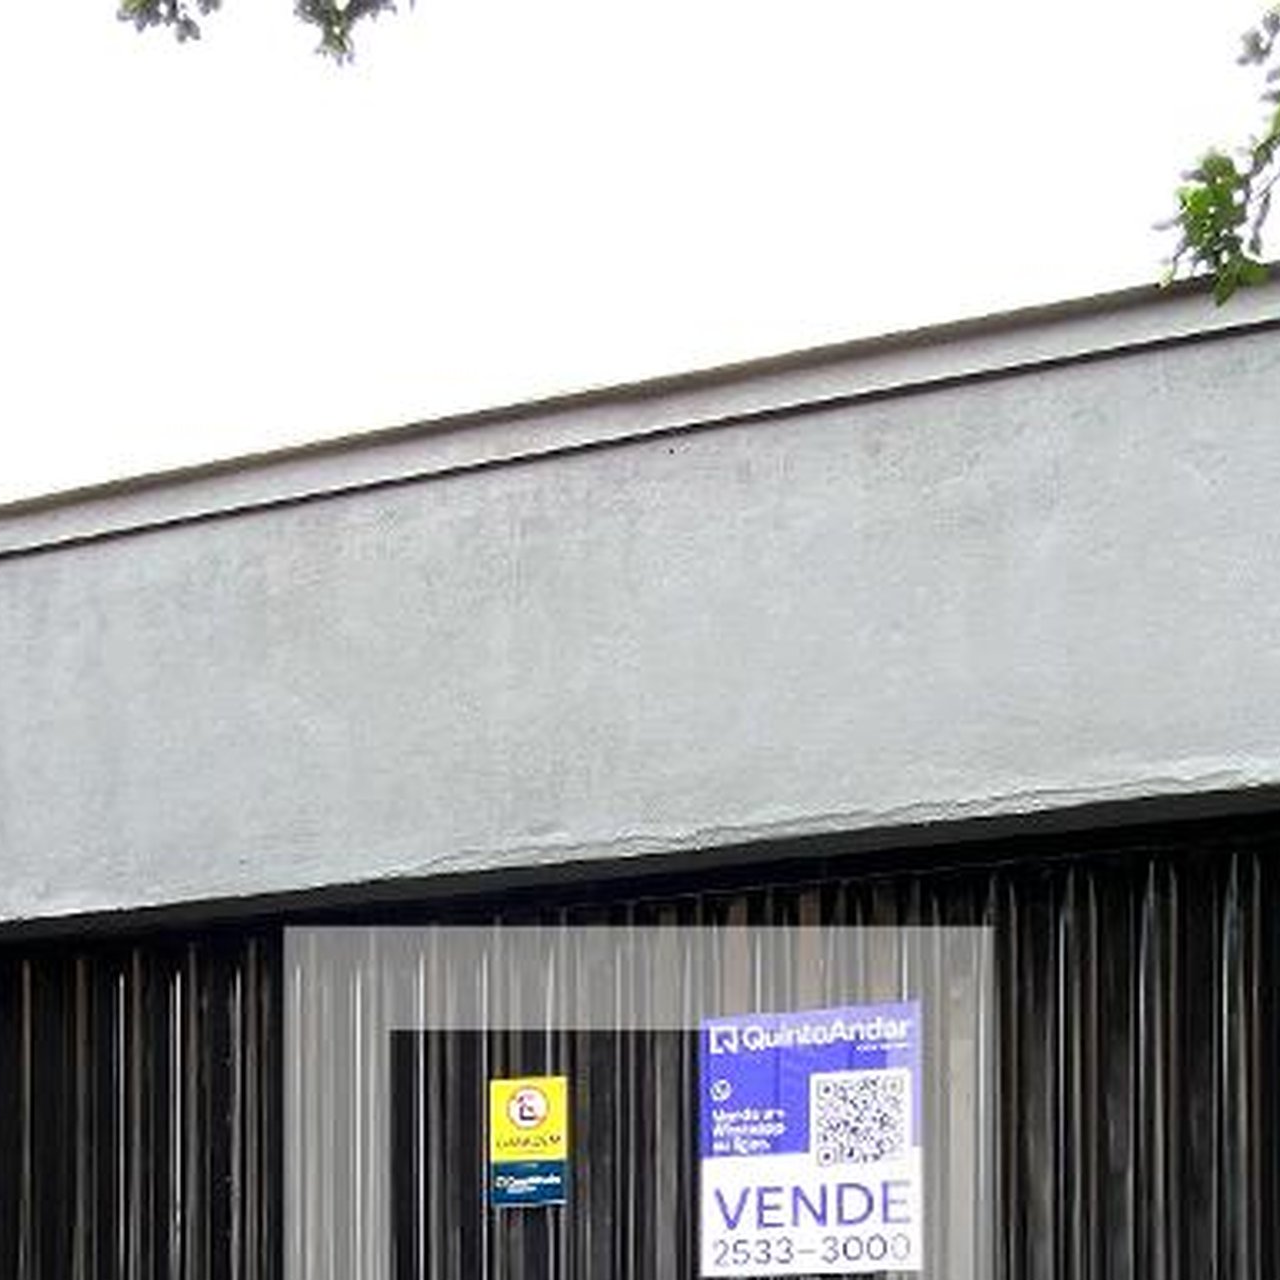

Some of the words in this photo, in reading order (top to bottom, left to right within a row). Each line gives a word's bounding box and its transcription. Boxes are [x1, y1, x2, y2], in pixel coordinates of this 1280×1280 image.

[741, 1017, 911, 1050] QuintoAndar
[714, 1180, 911, 1231] VENDE
[713, 1233, 911, 1265] 2533-3000
